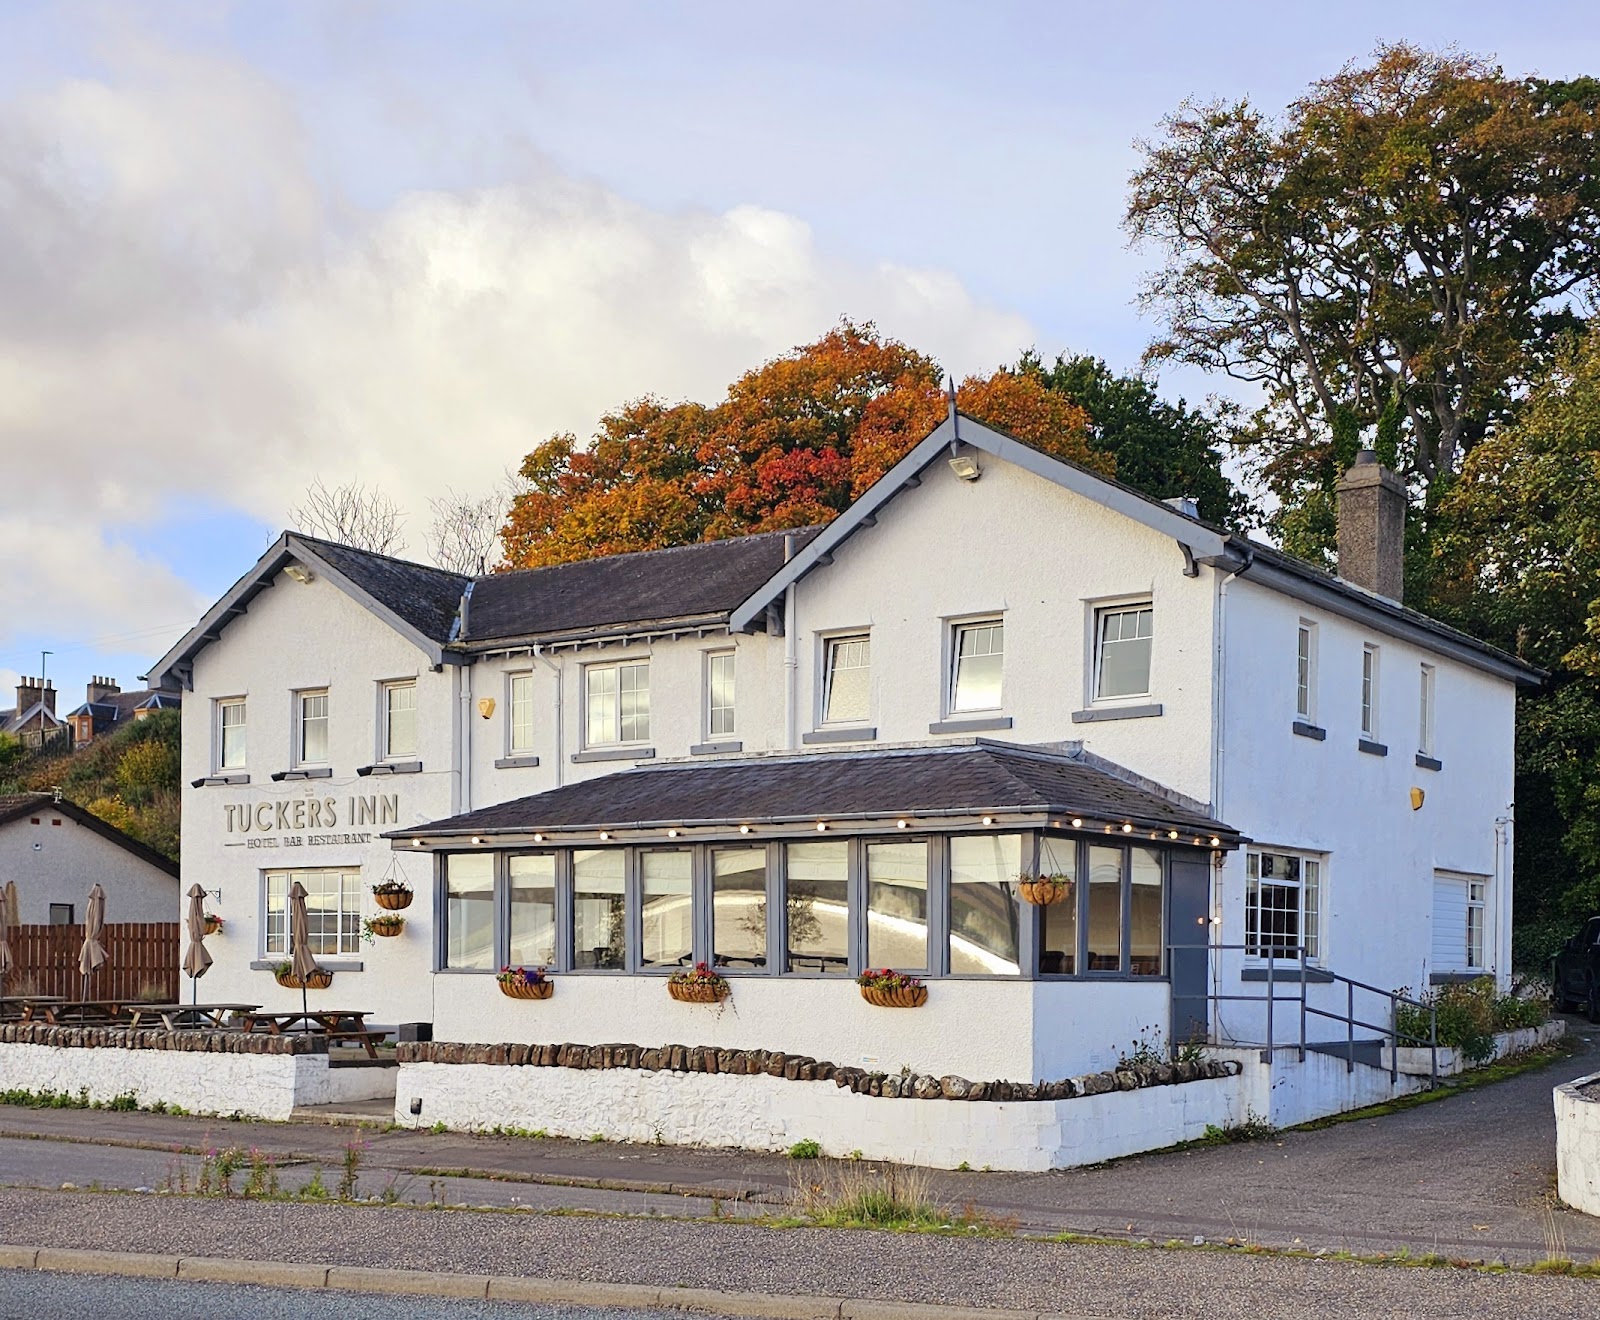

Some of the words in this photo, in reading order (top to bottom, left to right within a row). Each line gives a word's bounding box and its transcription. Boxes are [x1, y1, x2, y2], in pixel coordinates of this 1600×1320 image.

[224, 796, 337, 832] TUCKERS
[349, 794, 398, 826] INN
[247, 837, 279, 849] HOTEL
[284, 836, 303, 847] BAR
[308, 833, 372, 846] RESTAURANT
